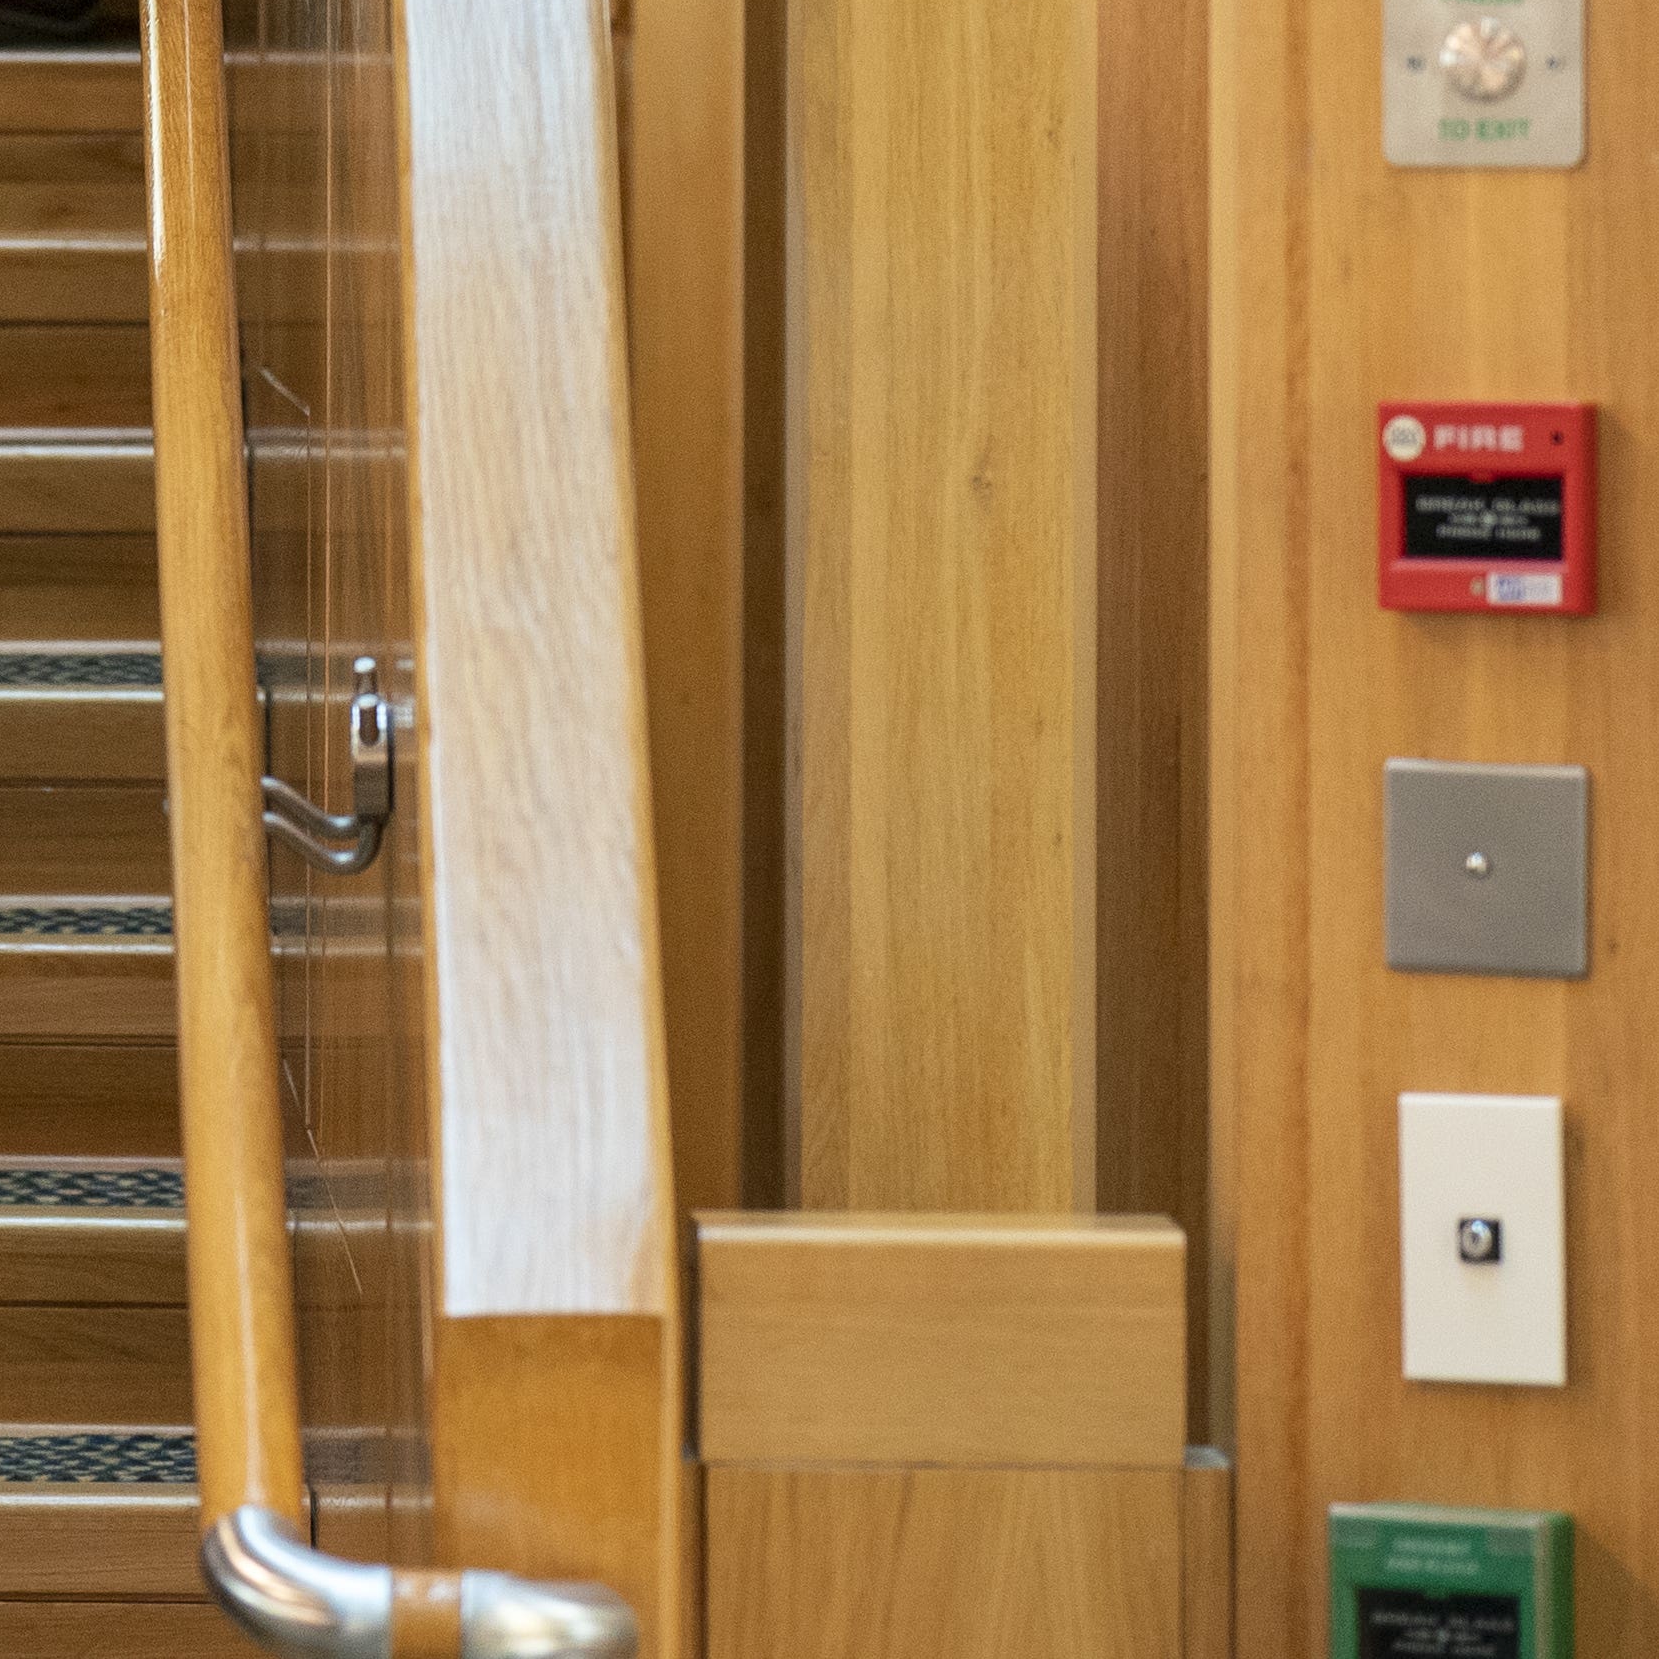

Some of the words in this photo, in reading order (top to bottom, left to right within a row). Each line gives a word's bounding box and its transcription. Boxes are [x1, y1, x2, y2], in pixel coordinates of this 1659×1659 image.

[1438, 118, 1470, 139] TO
[1475, 117, 1529, 140] EXIT
[1433, 425, 1524, 452] FIRE
